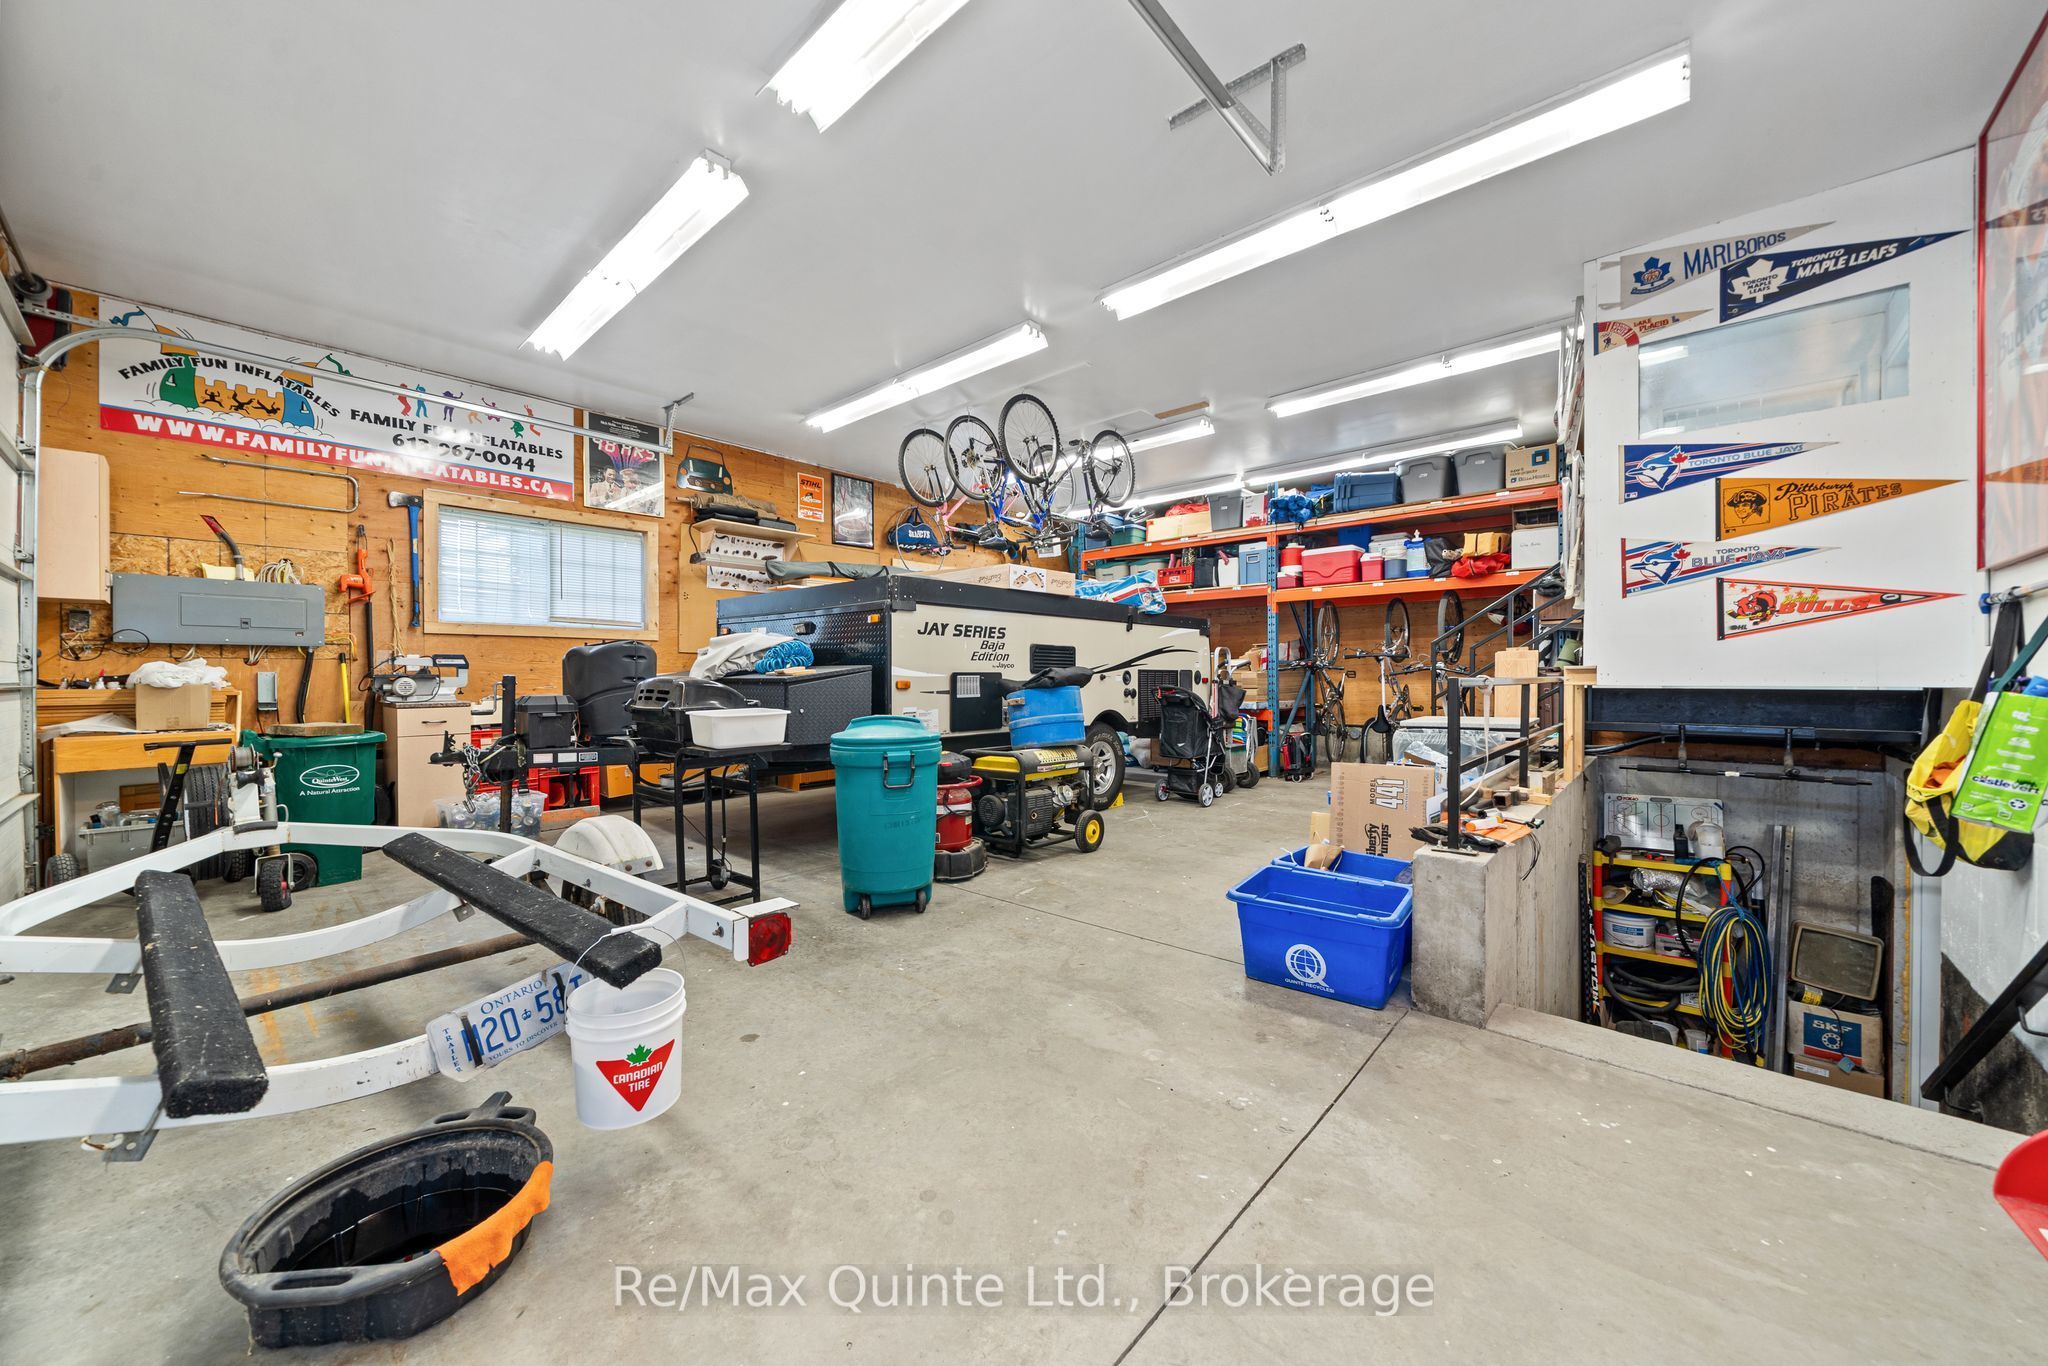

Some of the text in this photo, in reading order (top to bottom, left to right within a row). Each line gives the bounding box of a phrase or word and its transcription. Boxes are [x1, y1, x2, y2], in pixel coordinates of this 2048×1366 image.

[1684, 232, 1786, 280] MARLBOROS
[1791, 249, 1845, 267] TORONTO
[1796, 243, 1898, 280] MAPLE LEAFS
[1742, 273, 1779, 287] TORONTO
[1747, 281, 1772, 290] MAPLE
[1749, 285, 1771, 295] LEAFS
[117, 356, 341, 418] FAMILY FUN INFLATABLES
[350, 408, 416, 432] FAMILY
[469, 431, 563, 459] FLATABLES
[392, 433, 536, 472] 61967-0044
[1688, 444, 1805, 467] TORONTO BLUE JAYS
[800, 479, 821, 488] STIHL
[1775, 482, 1854, 501] Pittsburgh
[1787, 482, 1903, 521] PIRATES
[1691, 549, 1786, 568] BLUE JAYS
[1715, 546, 1760, 555] TORONTO
[1776, 598, 1872, 614] BULLS
[917, 621, 1006, 639] JAY SERIES
[980, 640, 1005, 652] Baja
[970, 651, 1010, 661] Edition
[307, 788, 330, 796] Natural
[1375, 777, 1405, 810] 441
[1365, 823, 1380, 855] iberty
[1284, 978, 1305, 986] QUINTE
[480, 979, 543, 1015] ONTARIO
[1812, 1019, 1852, 1034] SKF
[612, 1061, 663, 1084] CANADIAN
[628, 1079, 650, 1092] TIRE
